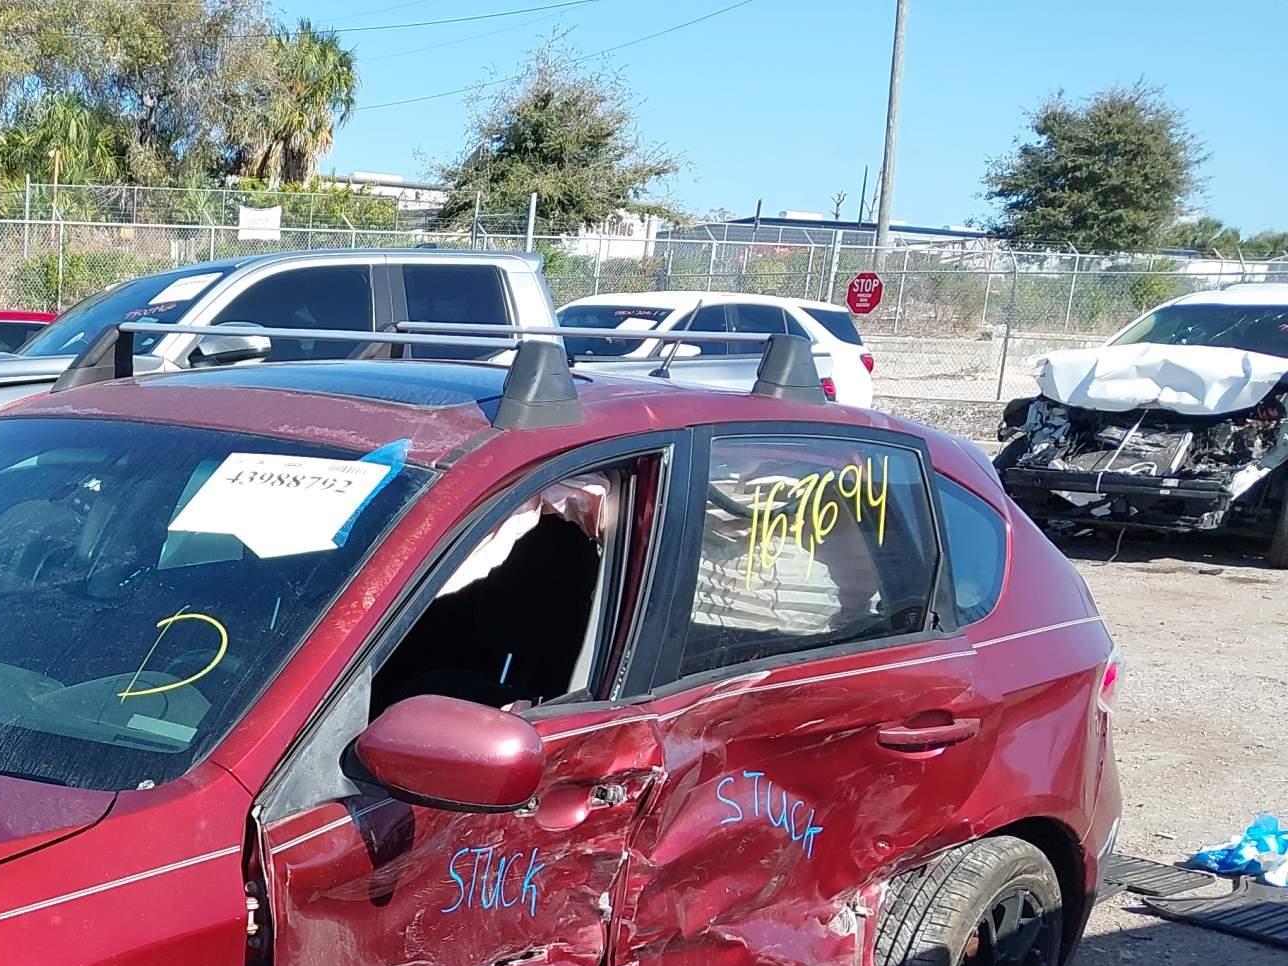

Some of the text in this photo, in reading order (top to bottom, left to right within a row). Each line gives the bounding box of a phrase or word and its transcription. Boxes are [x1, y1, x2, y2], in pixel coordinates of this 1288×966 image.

[853, 278, 880, 292] STOP
[226, 470, 353, 493] 43988792
[717, 770, 824, 859] STUCK
[441, 847, 546, 917] STUCK
